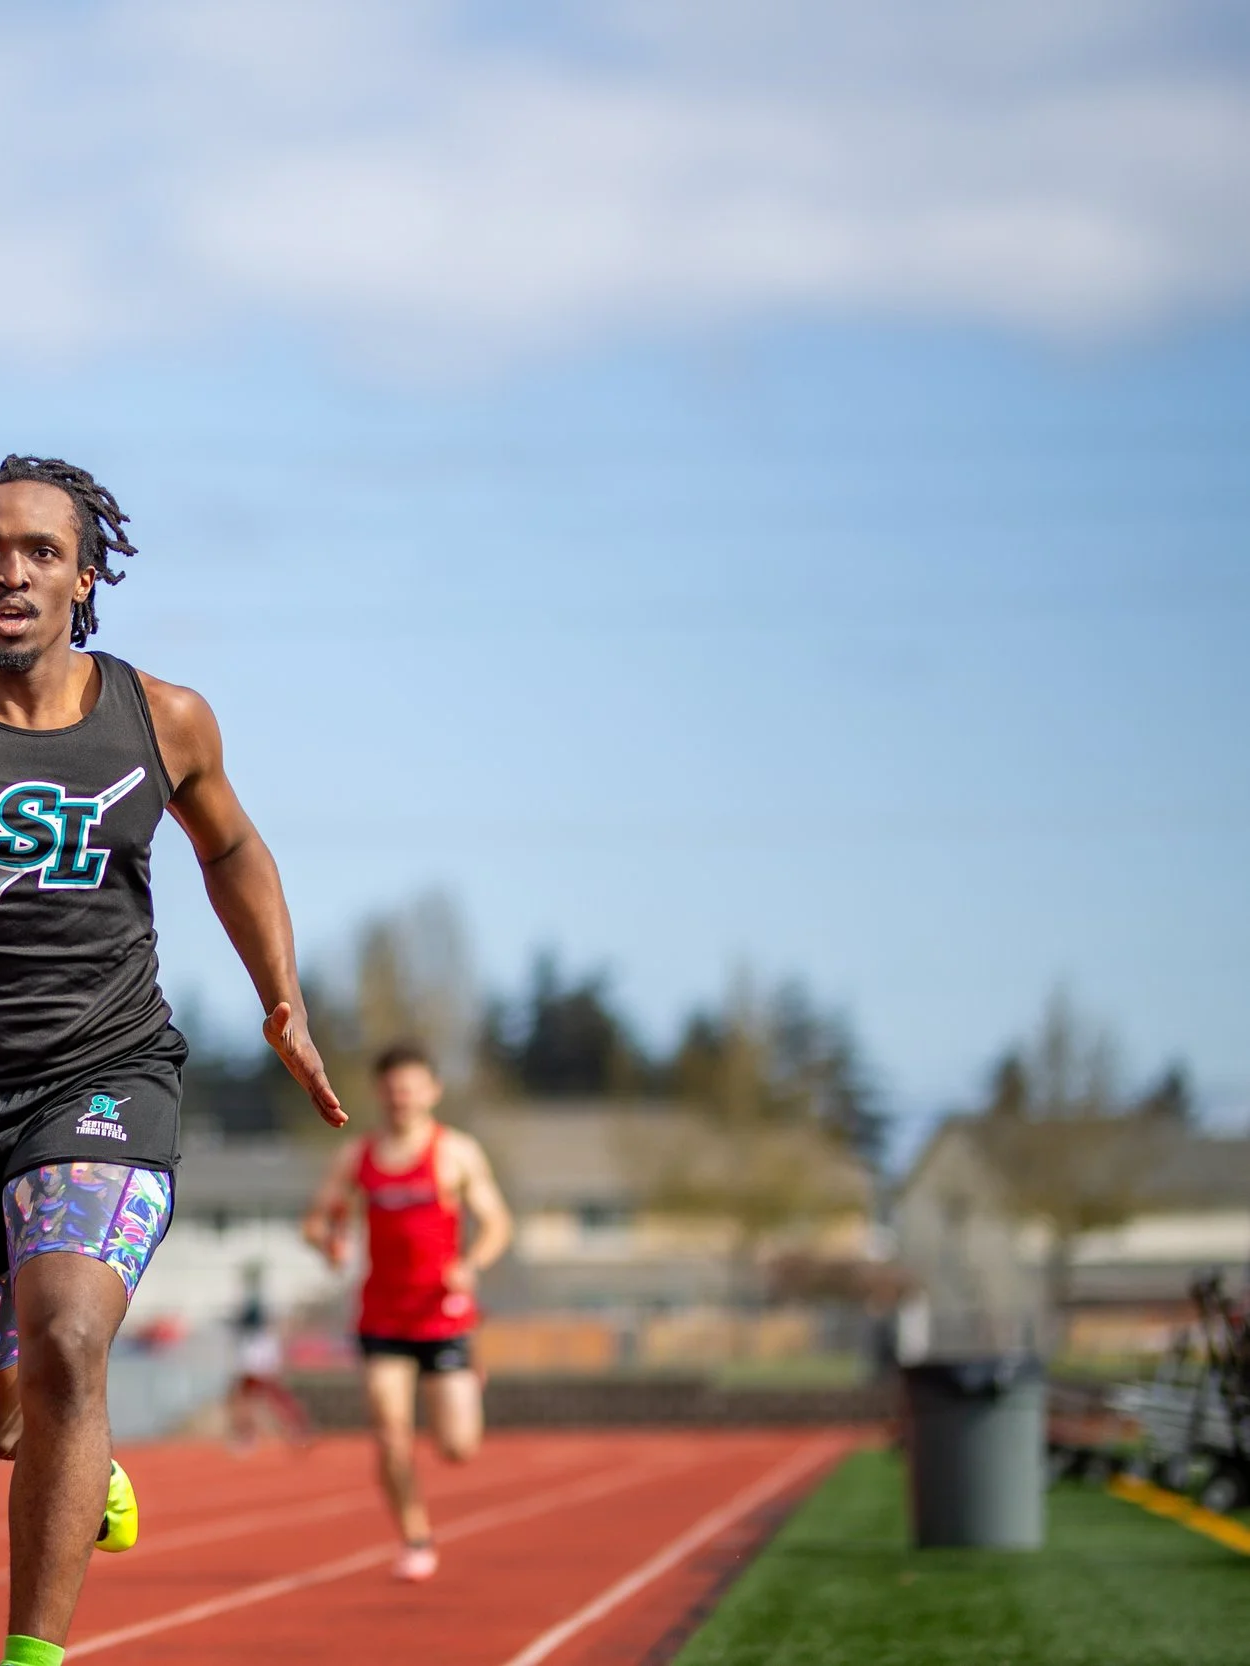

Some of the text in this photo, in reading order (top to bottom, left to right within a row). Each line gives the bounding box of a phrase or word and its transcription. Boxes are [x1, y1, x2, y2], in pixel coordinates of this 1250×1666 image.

[89, 1095, 120, 1120] SL
[76, 1126, 100, 1135] TRACK
[107, 1130, 127, 1141] FIELD
[82, 1120, 123, 1132] SENTINELS
